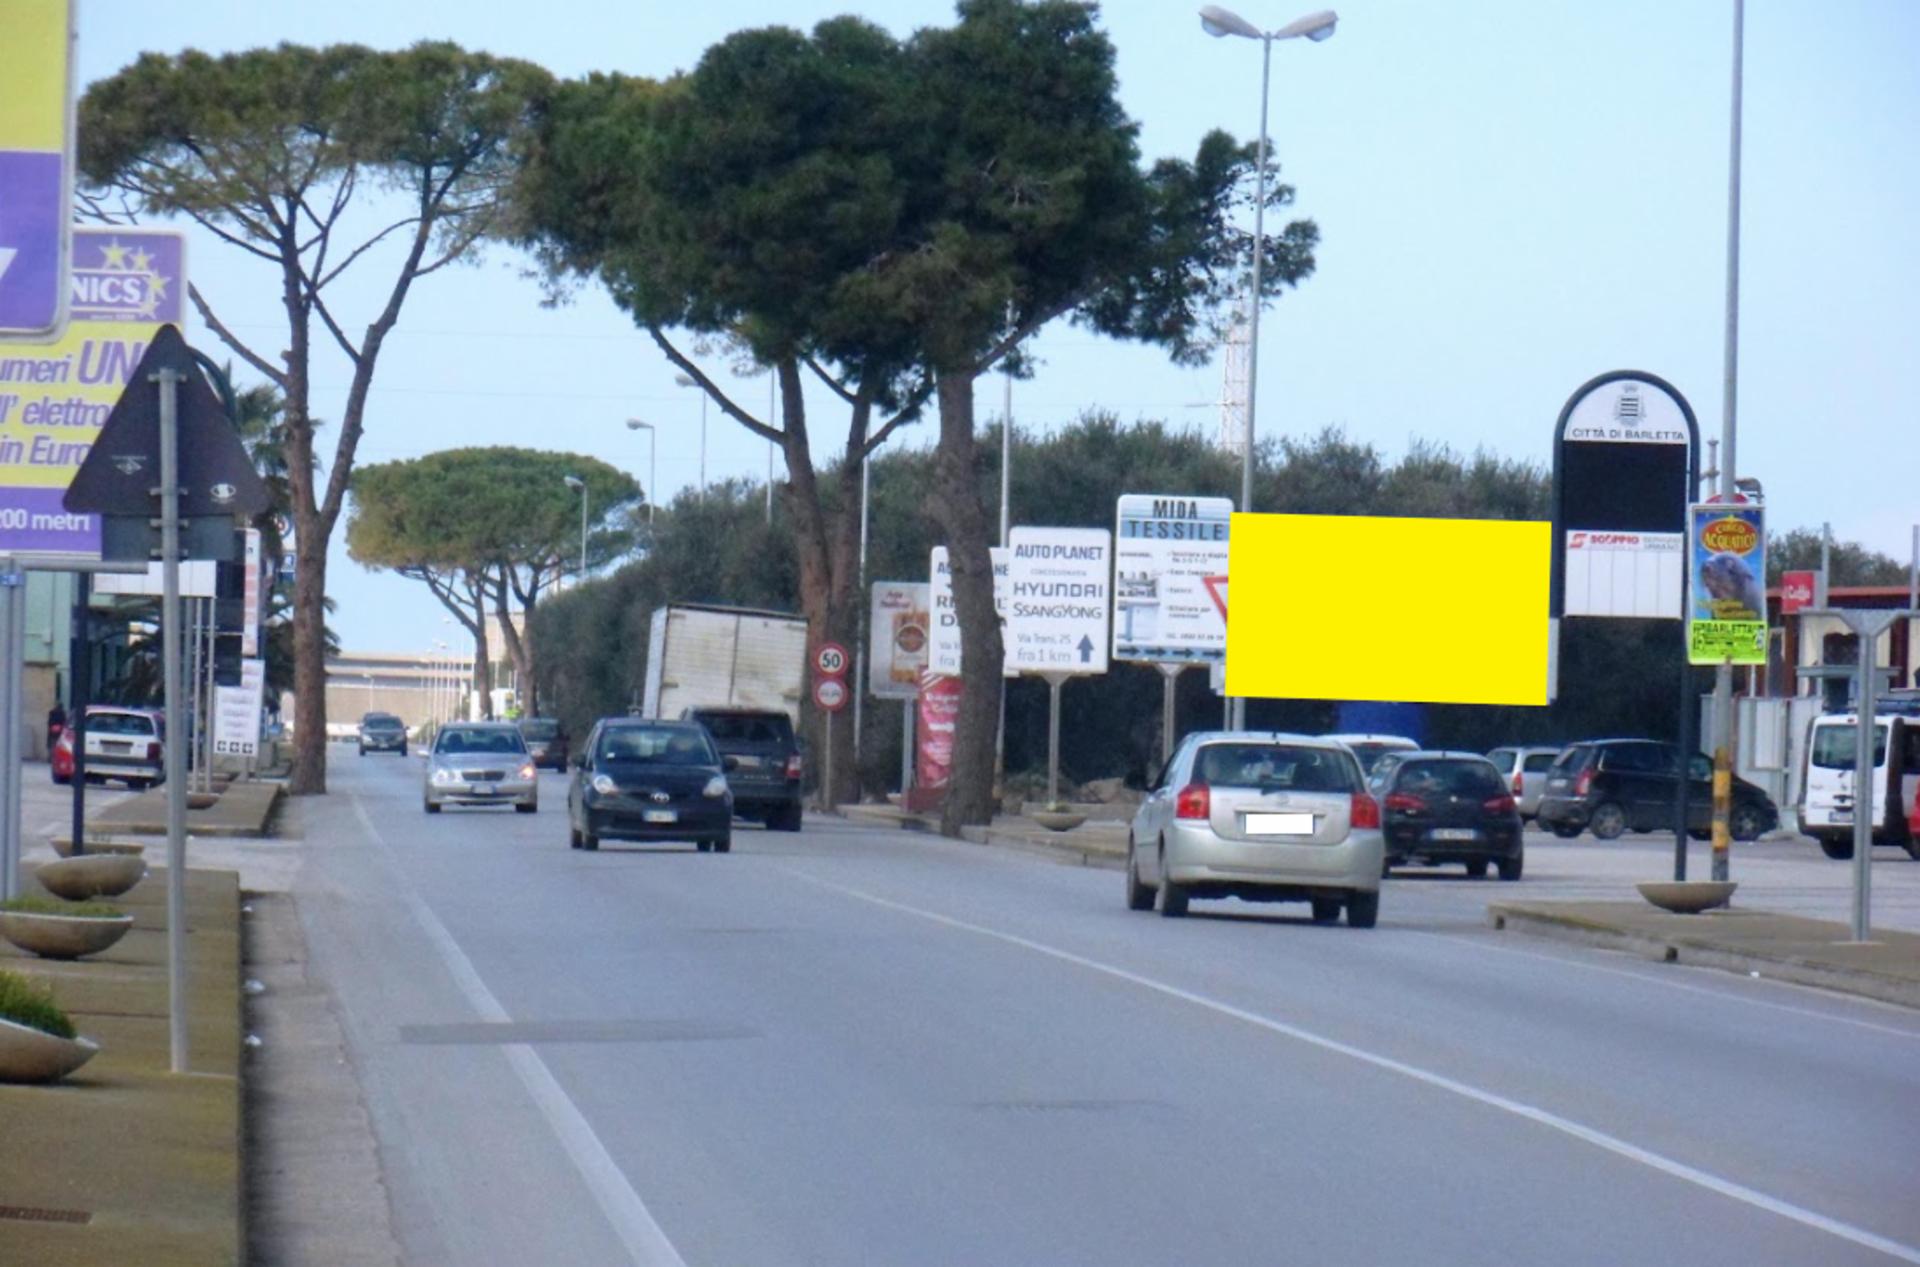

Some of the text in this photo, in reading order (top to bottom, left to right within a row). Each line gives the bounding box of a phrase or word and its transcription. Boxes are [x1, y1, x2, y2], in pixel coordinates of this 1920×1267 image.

[1609, 429, 1621, 438] DI
[1625, 430, 1685, 440] BARLETTA
[1153, 499, 1198, 520] MIDA
[0, 508, 90, 531] 00 metri
[1129, 520, 1224, 541] TESSILE
[1015, 544, 1051, 559] AUTO
[1053, 545, 1103, 561] PLANET
[1013, 582, 1103, 598] HYUNDAI
[822, 653, 841, 669] 50
[1018, 648, 1071, 663] fra 1 km
